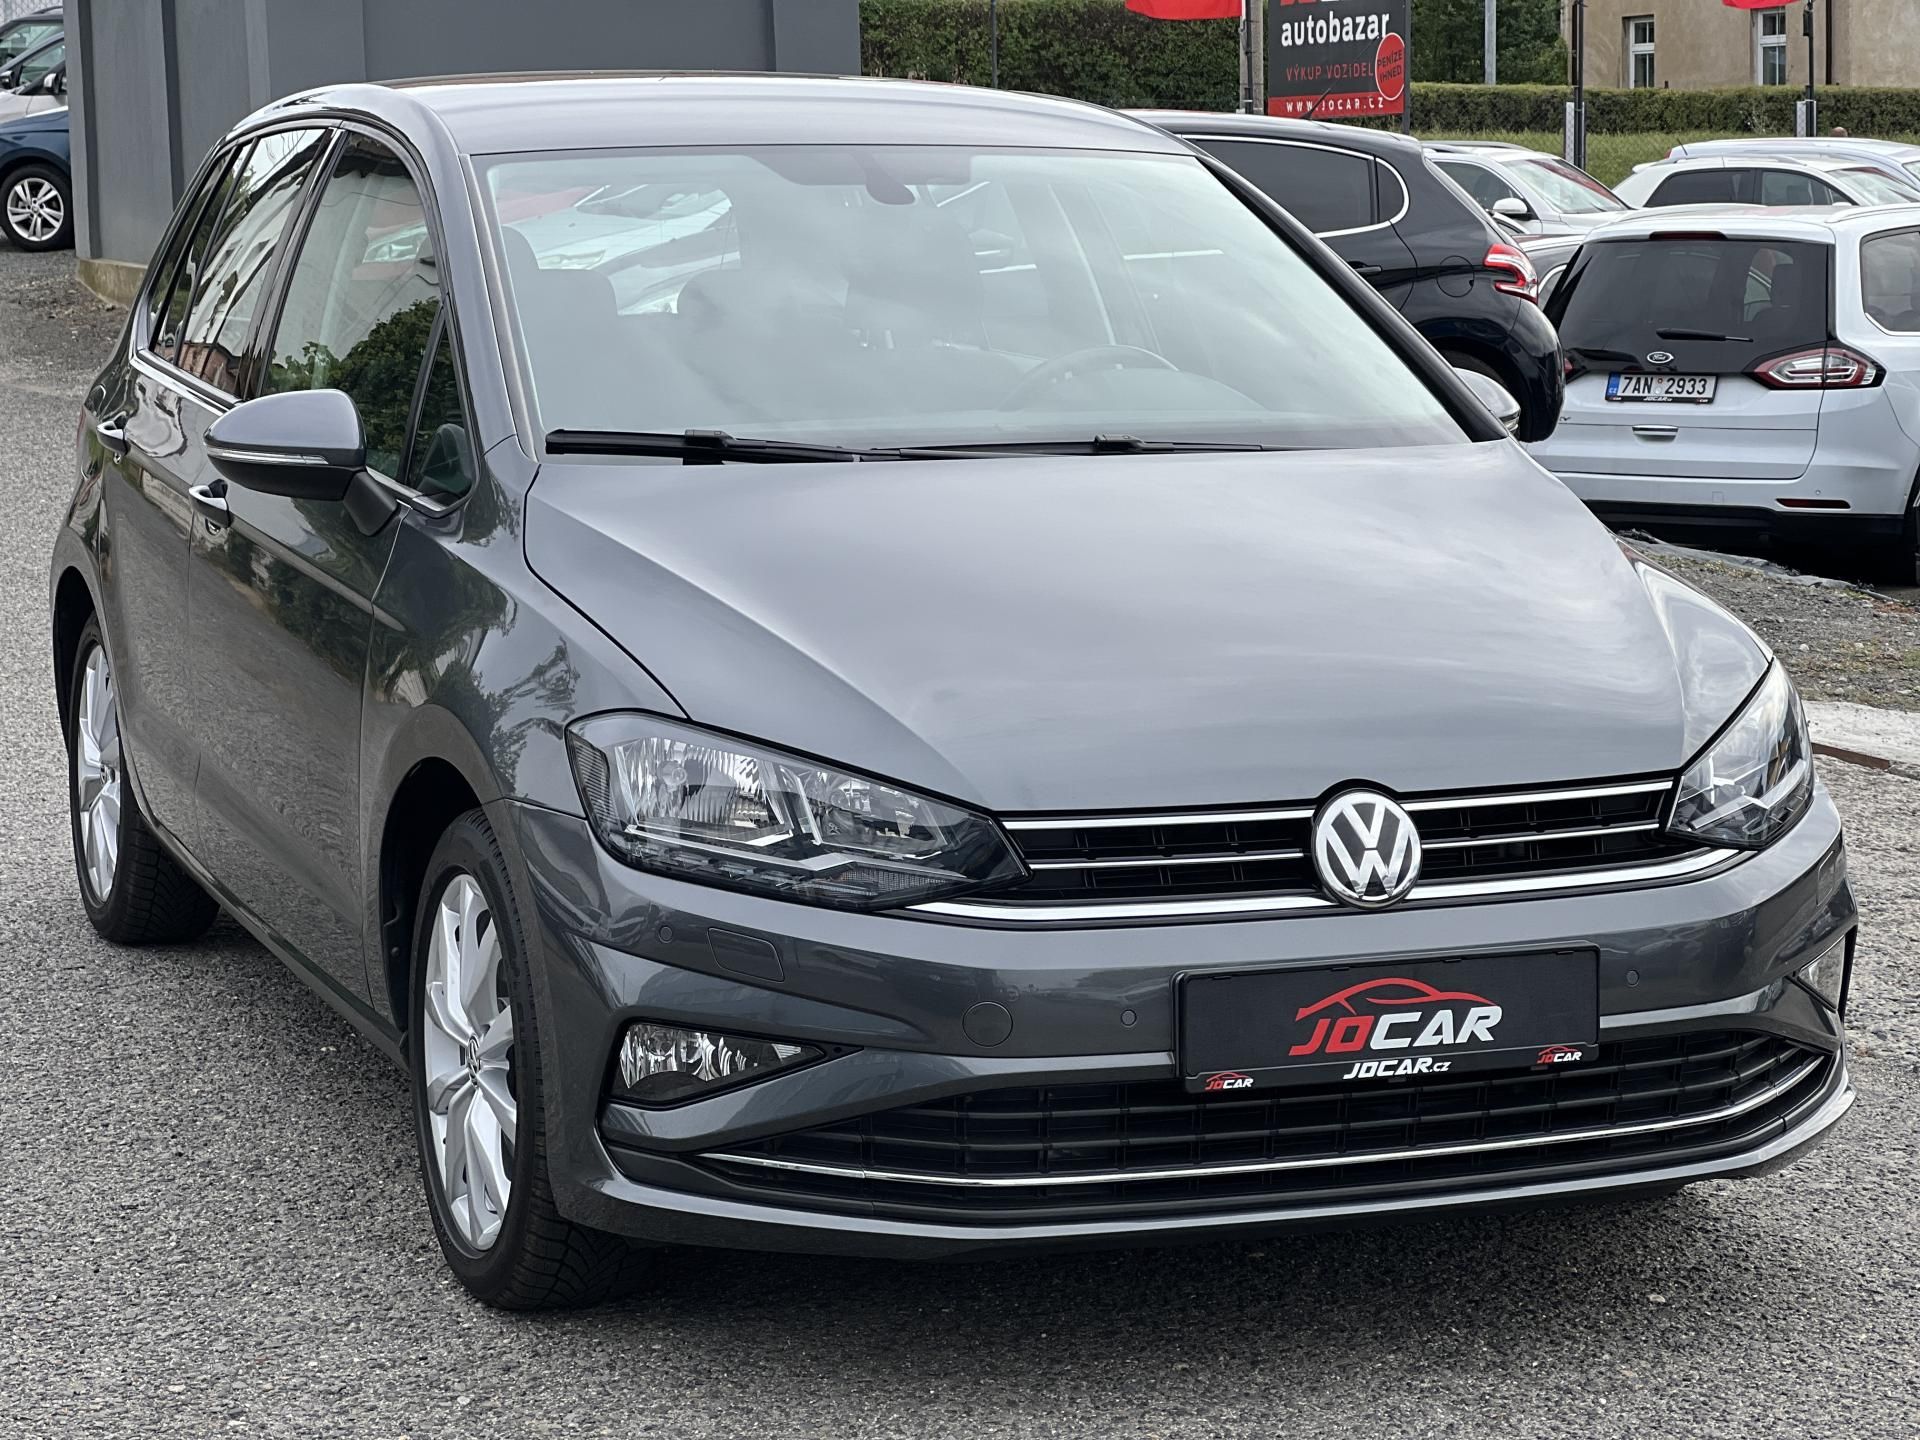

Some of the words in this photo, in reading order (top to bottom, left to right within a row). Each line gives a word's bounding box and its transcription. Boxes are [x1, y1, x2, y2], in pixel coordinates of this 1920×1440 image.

[1281, 10, 1390, 47] autobazar
[1286, 63, 1322, 81] VÝKUP
[1326, 61, 1374, 80] VOZIDEL
[1286, 96, 1385, 113] WWW.JOCAR.CZ
[1621, 376, 1654, 395] 7AN
[1664, 377, 1708, 395] 2933
[1288, 1005, 1503, 1057] JOCAR
[1536, 1051, 1583, 1064] JOCAR
[1342, 1057, 1452, 1080] JOCAR.cz
[1204, 1078, 1254, 1090] JOCAR
